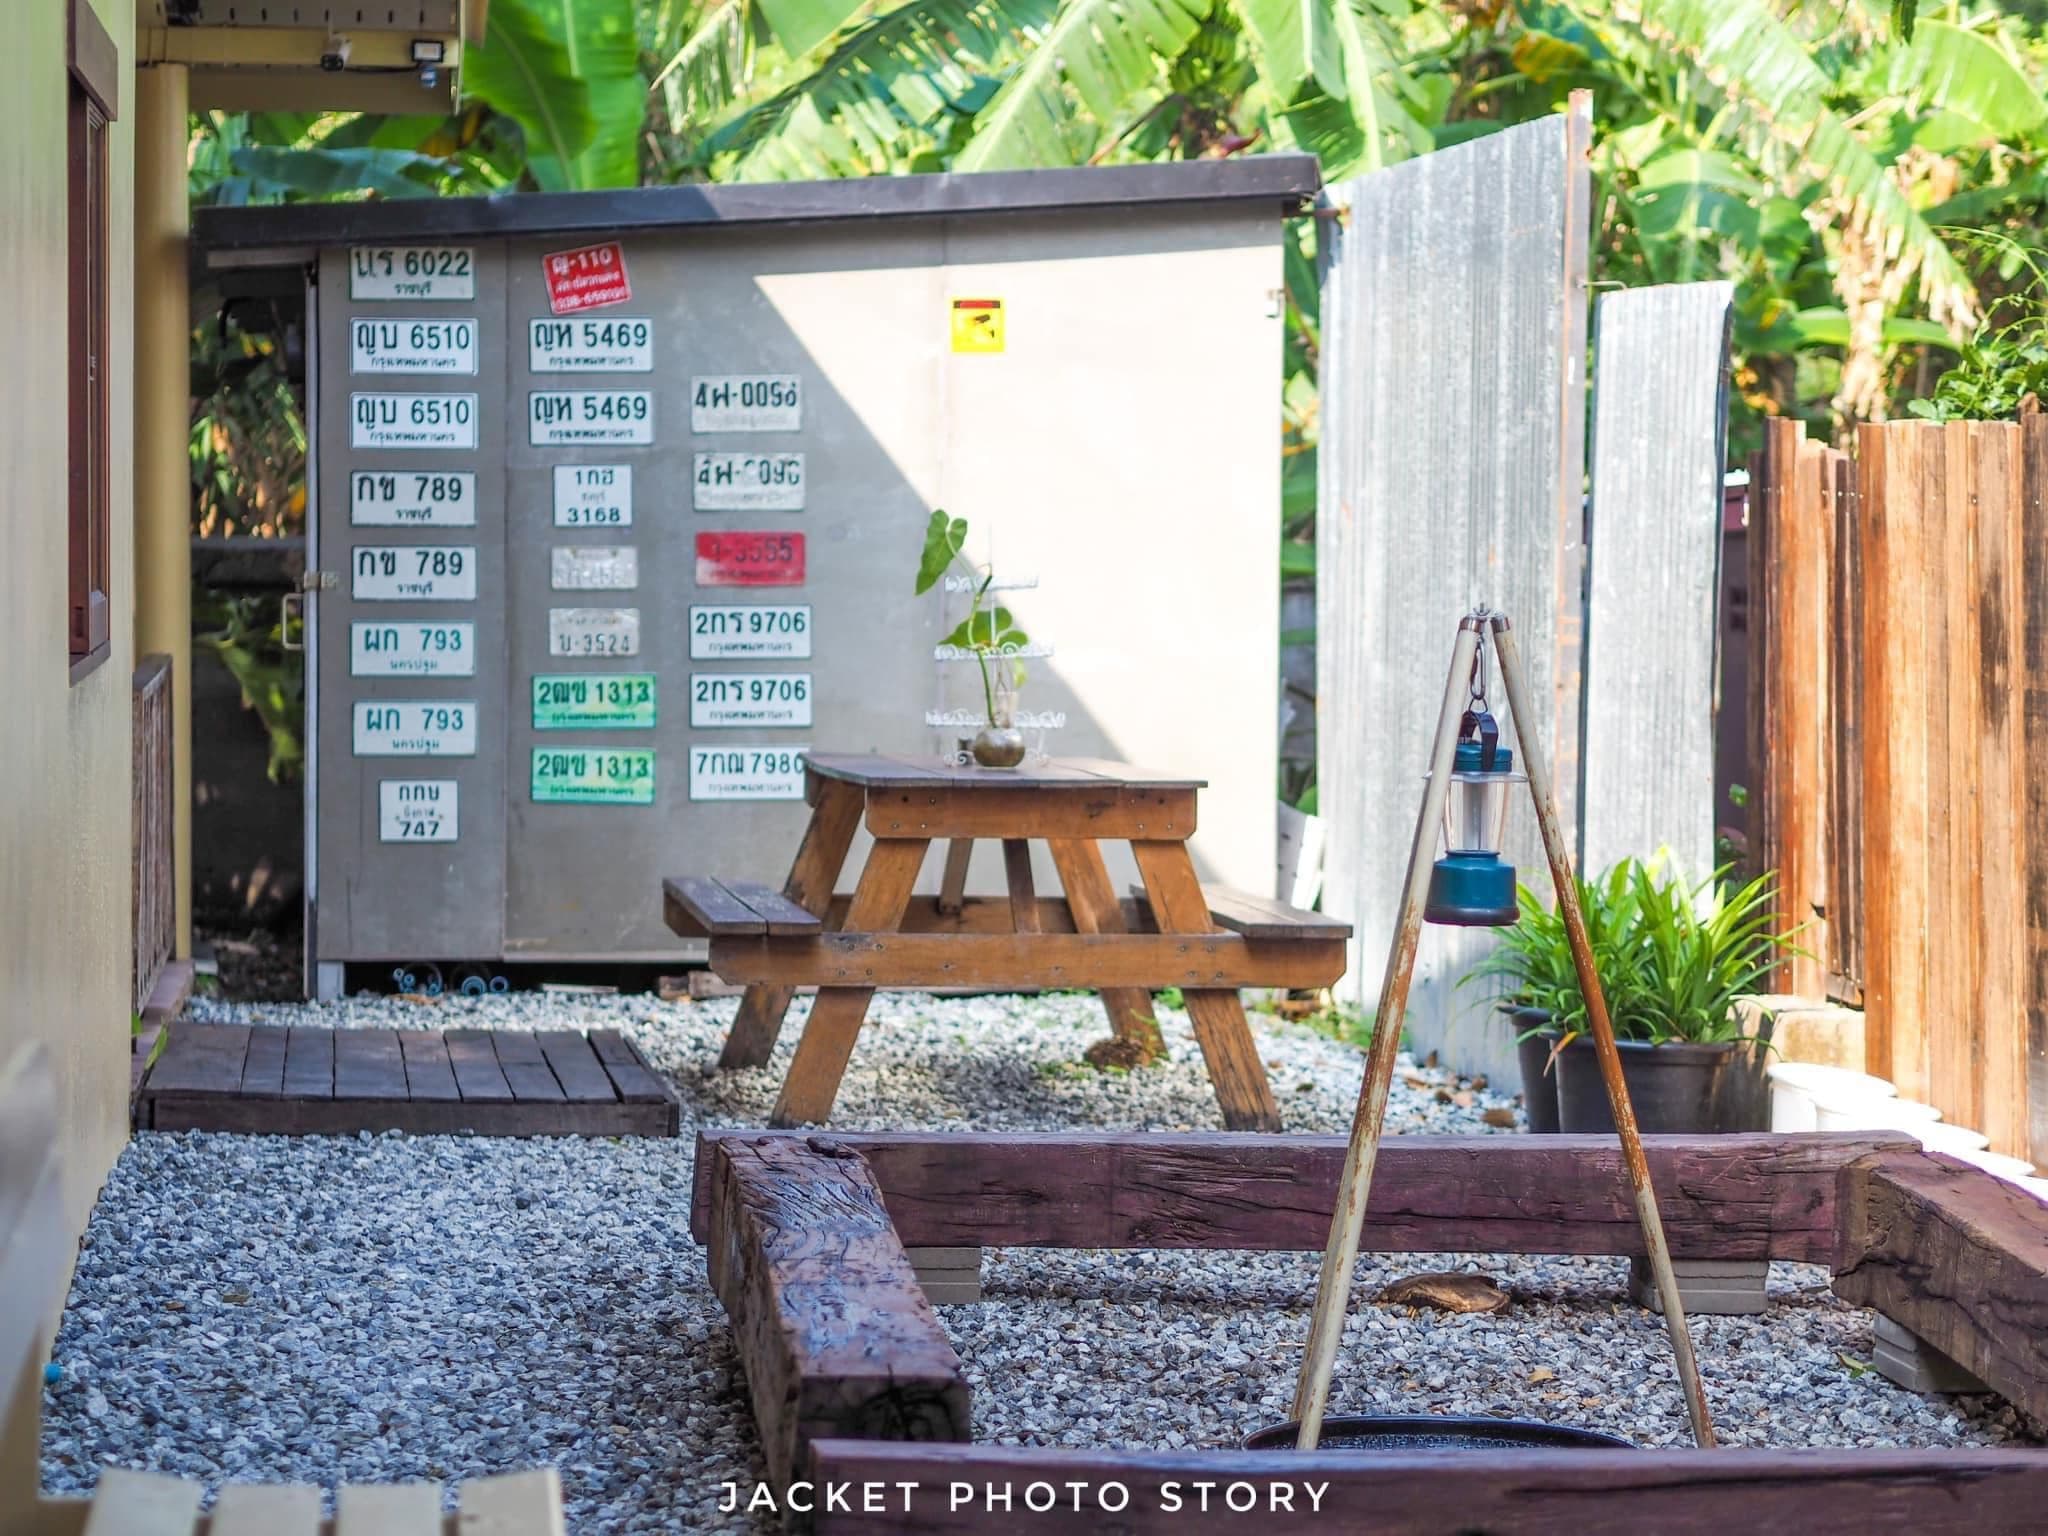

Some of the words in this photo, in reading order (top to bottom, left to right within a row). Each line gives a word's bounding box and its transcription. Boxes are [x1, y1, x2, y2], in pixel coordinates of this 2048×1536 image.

[404, 250, 470, 277] 6022
[356, 323, 398, 356] ญบ
[410, 324, 471, 350] 6510
[534, 322, 572, 351] ญท
[583, 322, 648, 349] 5469
[356, 398, 397, 430] ญบ
[410, 399, 470, 425] 6510
[534, 396, 572, 425] ญท
[583, 396, 648, 421] 5469
[414, 475, 463, 502] 789
[567, 507, 621, 523] 3168
[414, 551, 464, 577] 789
[695, 612, 744, 635] 2กร
[749, 612, 806, 634] 9706
[419, 628, 463, 652] 793
[596, 680, 650, 705] 1313
[696, 680, 744, 703] 2กร
[750, 680, 807, 702] 9706
[421, 707, 465, 732] 793
[595, 754, 649, 779] 1313
[398, 820, 440, 837] 747
